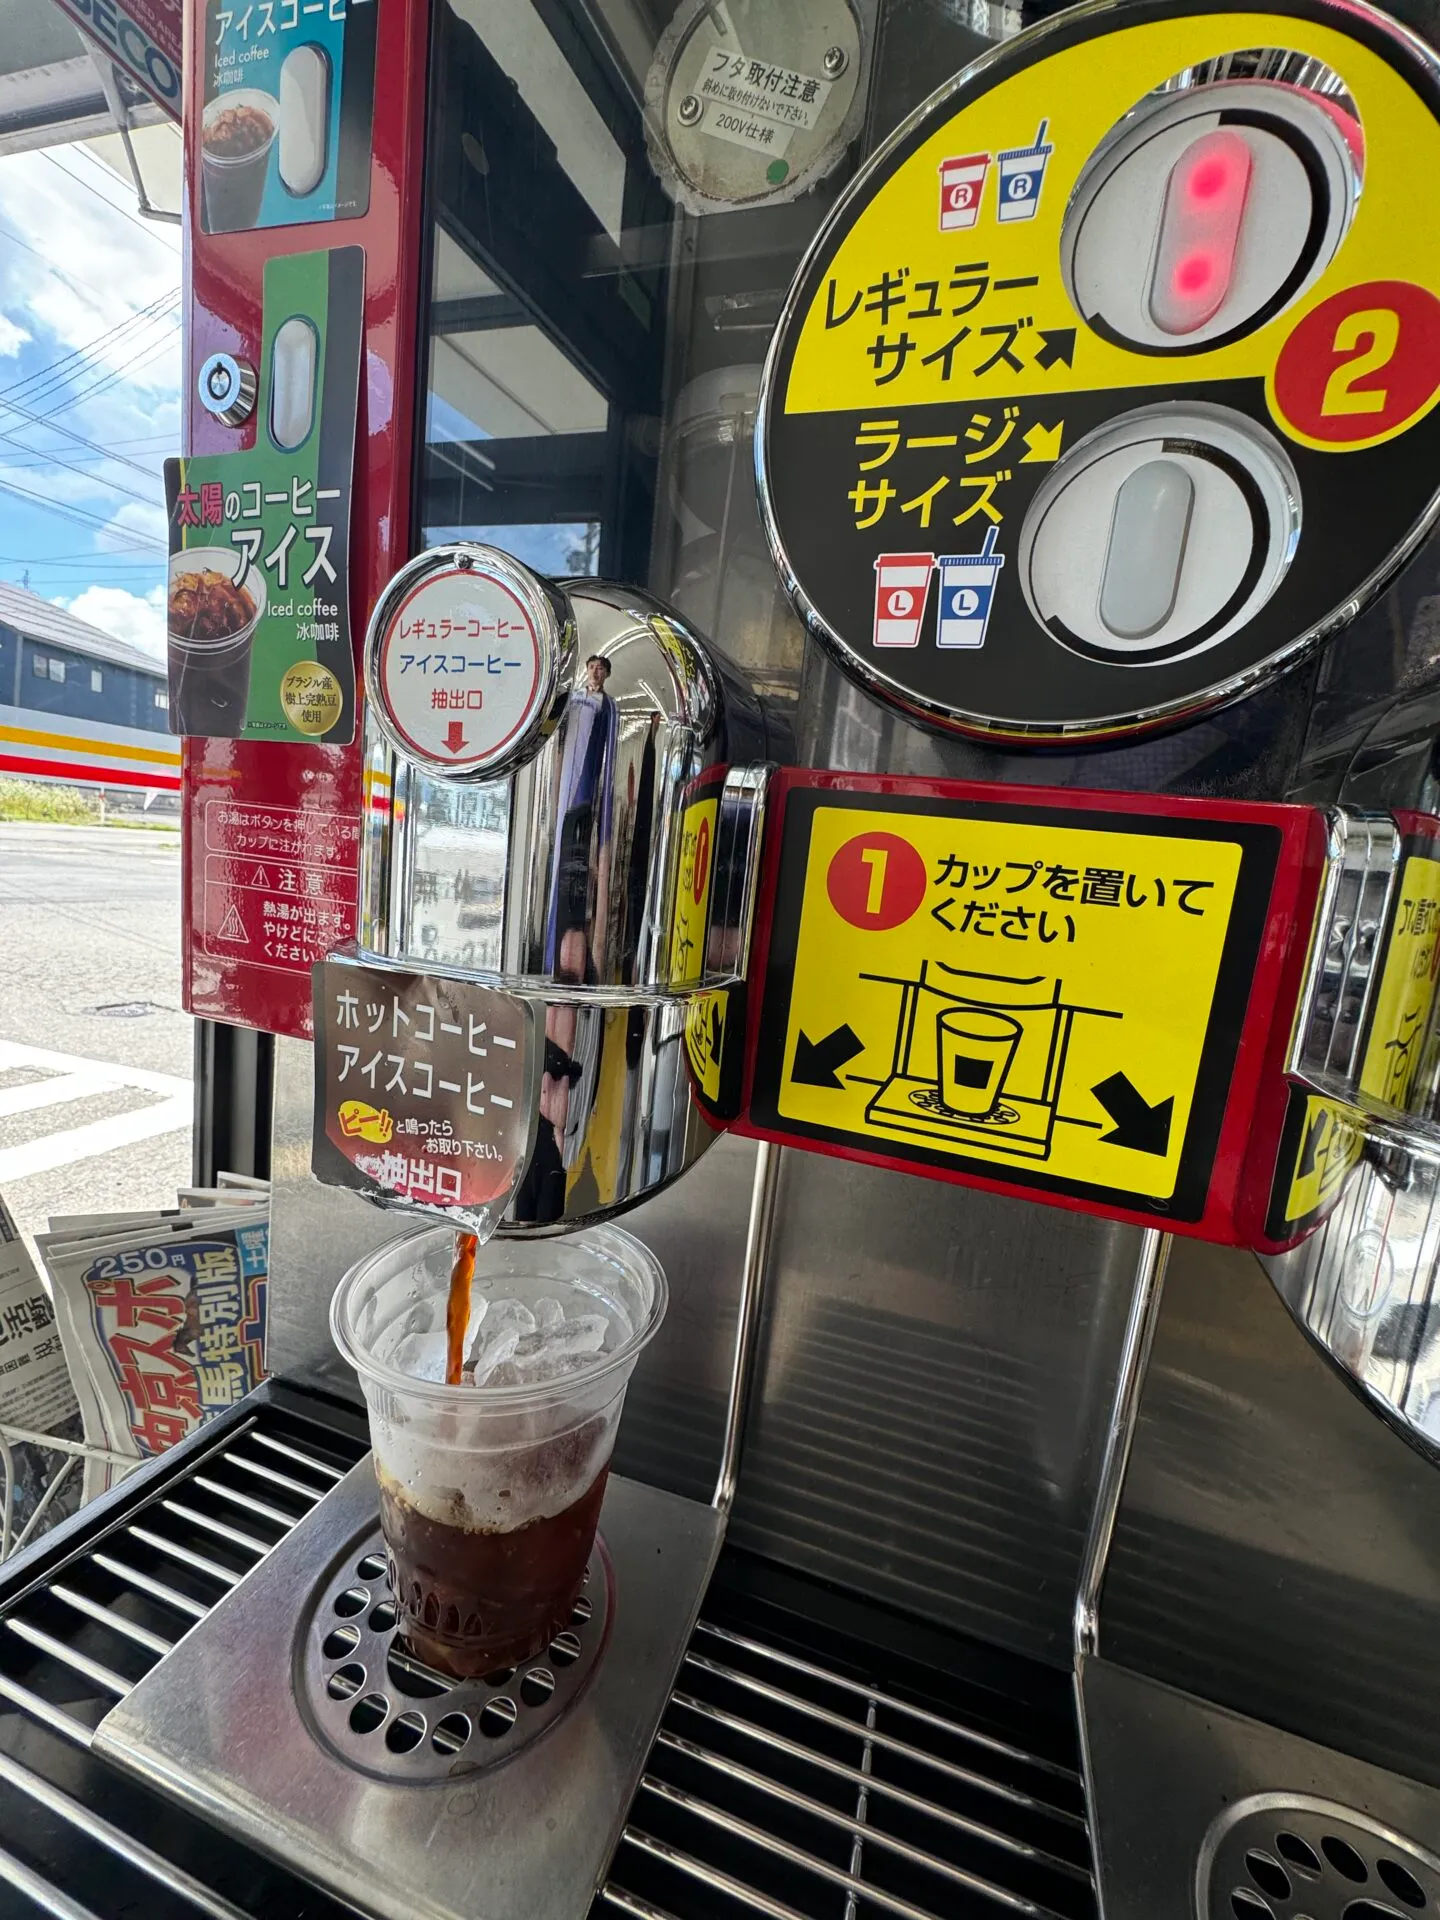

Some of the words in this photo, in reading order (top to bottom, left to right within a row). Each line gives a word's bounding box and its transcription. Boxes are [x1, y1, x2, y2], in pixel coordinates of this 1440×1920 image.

[70, 0, 182, 98] ECO
[214, 50, 236, 68] Iced
[238, 44, 270, 64] coffee
[712, 52, 821, 103] フタ取付注意
[715, 113, 775, 144] 200V仕様
[954, 189, 969, 205] R
[1013, 178, 1028, 195] R
[824, 260, 1040, 330] レギュラー
[866, 316, 1035, 387] サイズ
[1320, 308, 1401, 417] 2
[854, 406, 1021, 473] ラージ
[177, 476, 341, 527] 太陽のコーヒー
[847, 470, 1013, 530] サイズ
[231, 523, 338, 589] アイス
[267, 600, 293, 617] Iced
[297, 597, 338, 617] coffee
[893, 594, 906, 613] L
[958, 592, 972, 612] L
[296, 623, 340, 642] 冰咖啡
[399, 618, 525, 640] レギュラーコーヒー
[399, 654, 521, 674] アイスコーヒー
[286, 676, 333, 690] ブラジル産
[431, 688, 483, 710] 抽出口
[302, 709, 322, 723] 使用
[860, 849, 889, 916] 1
[932, 852, 1216, 917] カップを置いて
[263, 900, 351, 931] 熱湯が出ます。
[930, 898, 1076, 945] ください
[335, 988, 517, 1058] ホットコーヒー
[335, 1043, 513, 1116] アイスコーヒー
[425, 1137, 503, 1162] お取り下さい。
[95, 1247, 186, 1279] 250円
